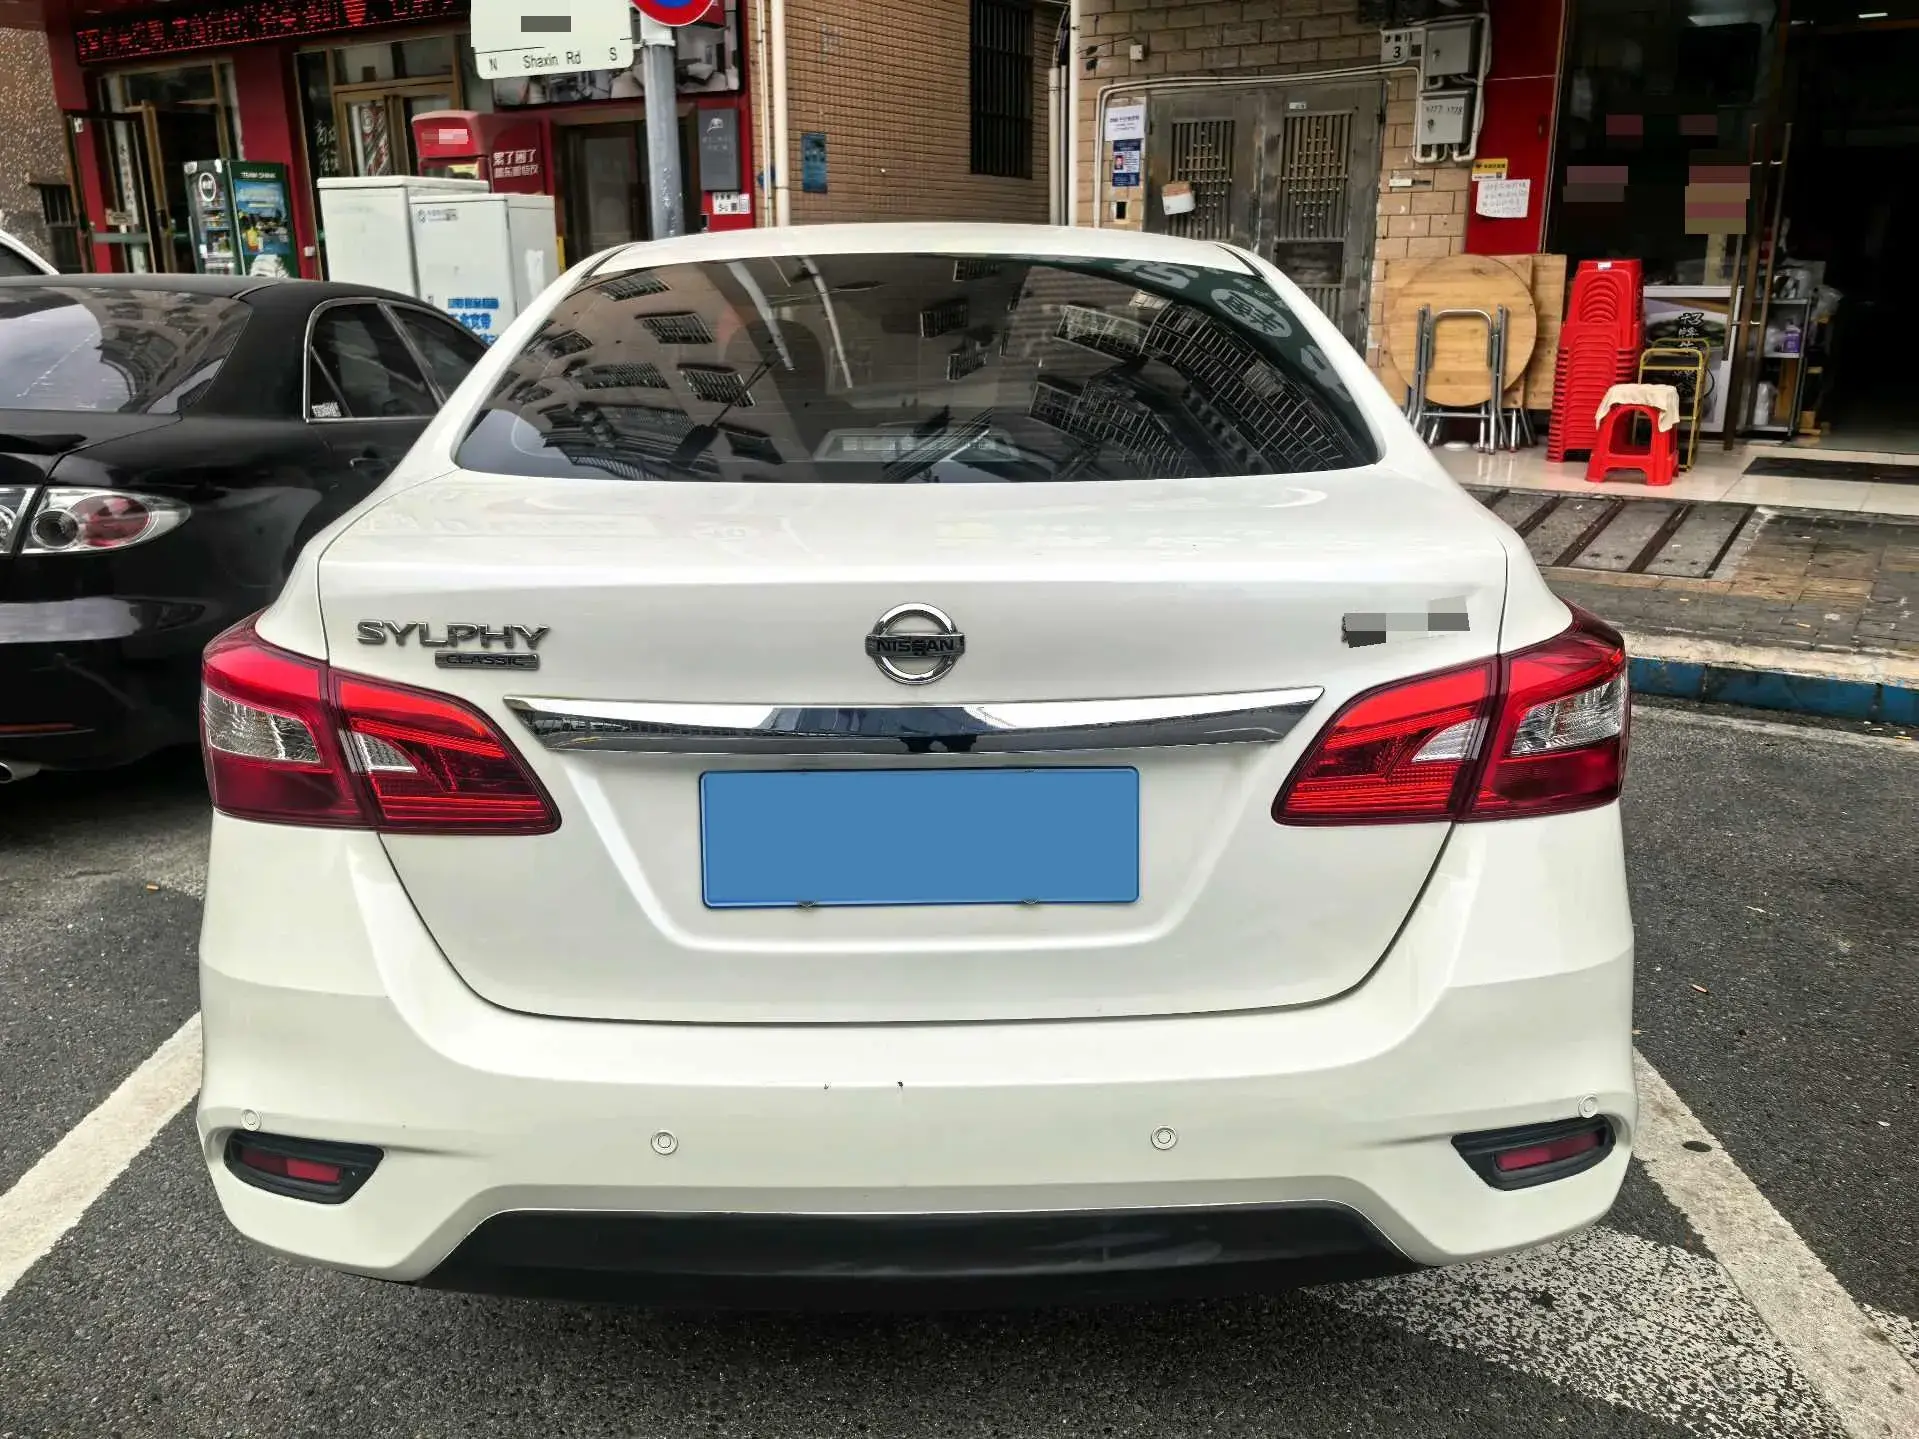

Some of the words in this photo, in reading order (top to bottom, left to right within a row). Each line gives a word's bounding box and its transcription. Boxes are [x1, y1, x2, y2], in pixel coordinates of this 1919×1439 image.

[488, 57, 498, 71] N
[522, 53, 559, 69] Shaxin
[566, 51, 582, 65] Rd
[609, 47, 618, 61] S
[493, 149, 537, 167] 累了困了
[356, 619, 550, 650] SYLPHY
[877, 638, 954, 653] NISSAN
[446, 654, 526, 666] CLASSIC
